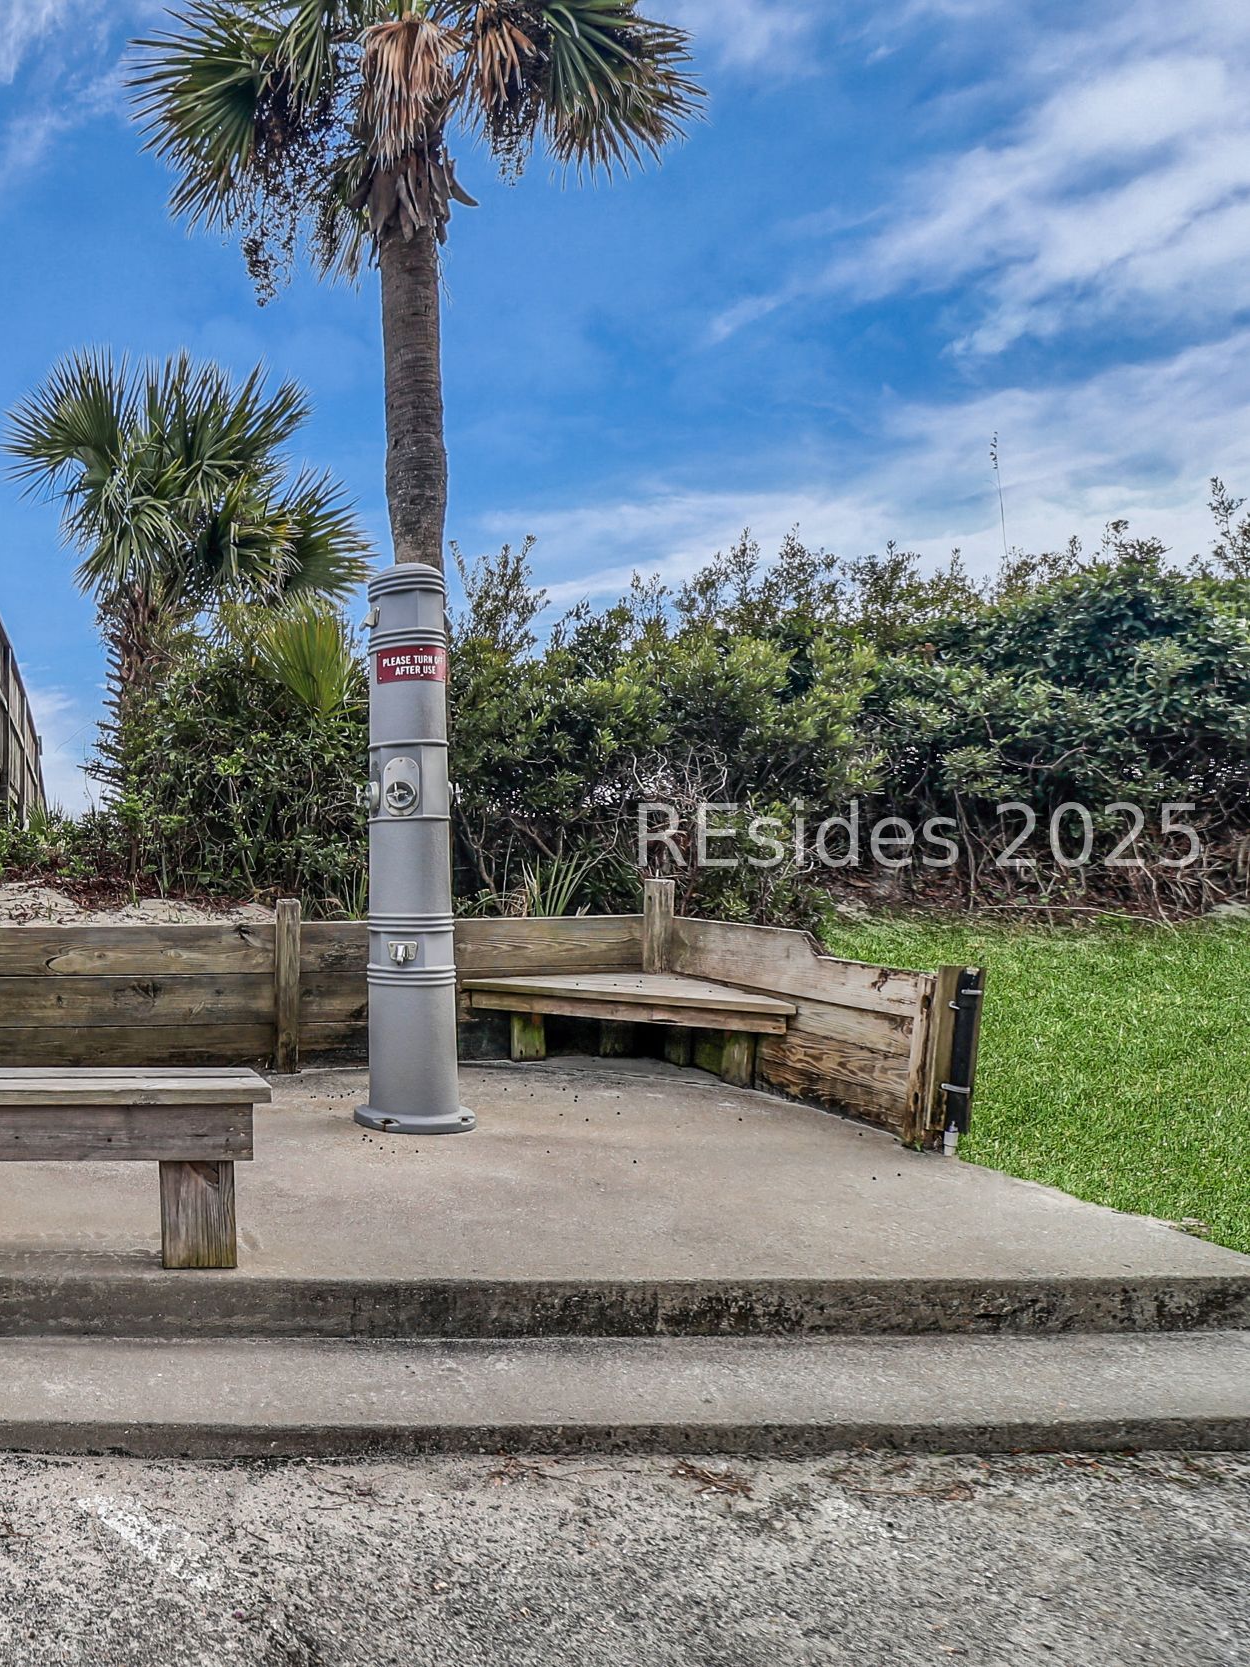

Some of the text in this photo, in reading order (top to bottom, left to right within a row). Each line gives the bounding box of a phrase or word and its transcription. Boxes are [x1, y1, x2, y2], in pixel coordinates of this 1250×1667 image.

[382, 655, 411, 667] PLEASE
[413, 655, 433, 664] TURN
[395, 665, 436, 676] AFTER USE
